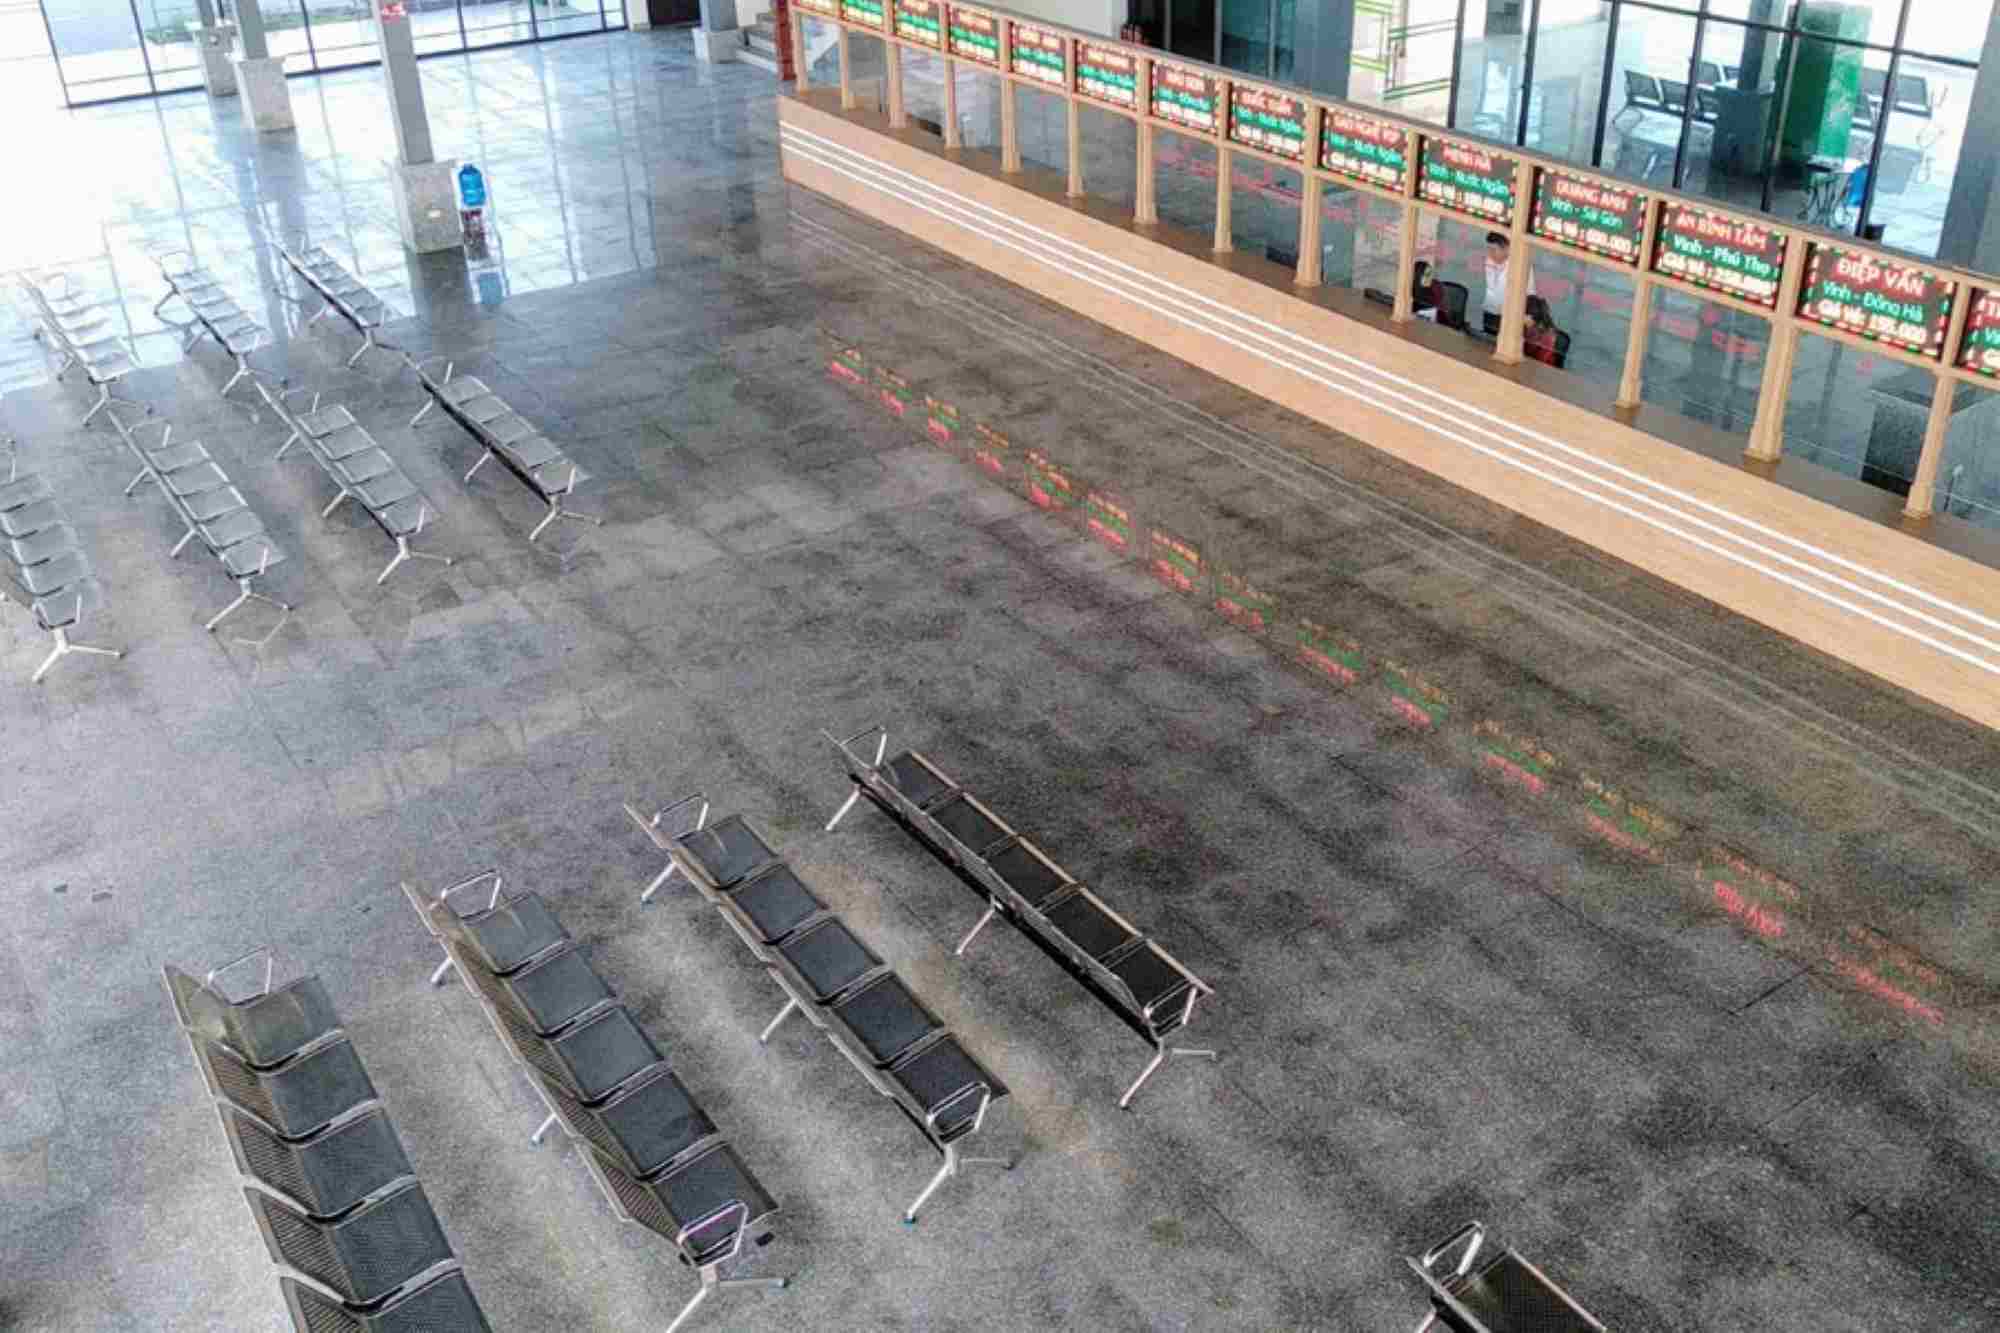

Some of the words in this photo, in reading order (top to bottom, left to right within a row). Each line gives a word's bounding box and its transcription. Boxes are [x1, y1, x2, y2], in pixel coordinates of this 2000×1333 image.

[1673, 234, 1702, 256] Vinh
[1713, 245, 1743, 267] Phú
[1836, 254, 1880, 285] ĐIỆP
[1822, 279, 1852, 302] Vinh
